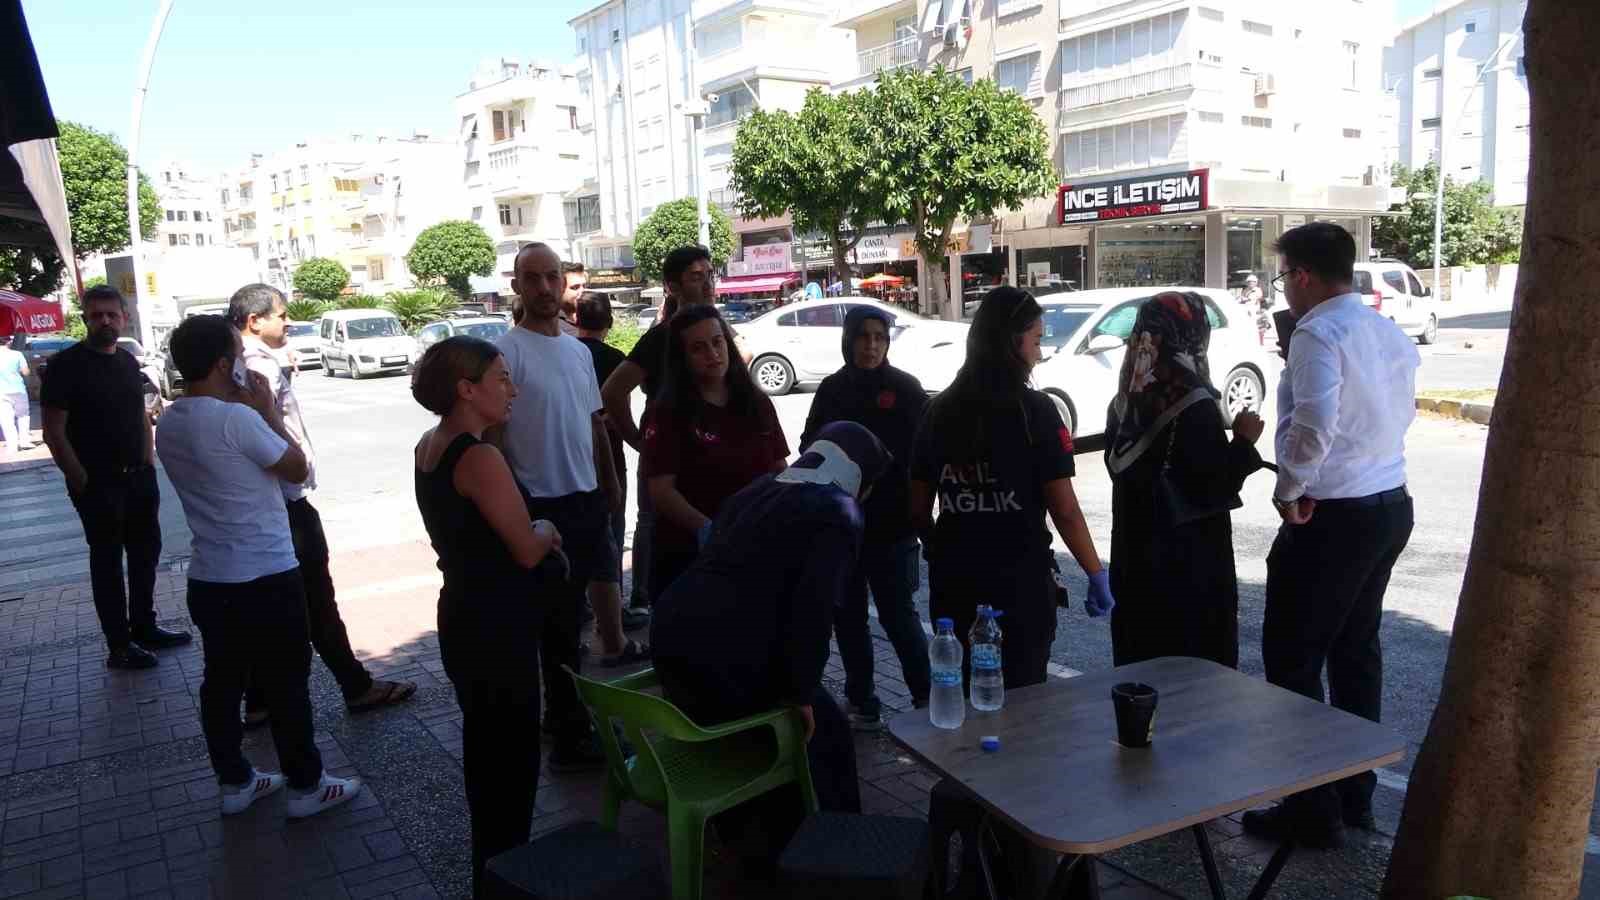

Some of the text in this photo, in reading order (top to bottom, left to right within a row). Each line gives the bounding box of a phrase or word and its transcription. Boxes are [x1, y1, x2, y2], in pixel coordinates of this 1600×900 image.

[1065, 176, 1200, 210] İNCE İLETİŞİM
[939, 488, 1024, 514] AĞLIK
